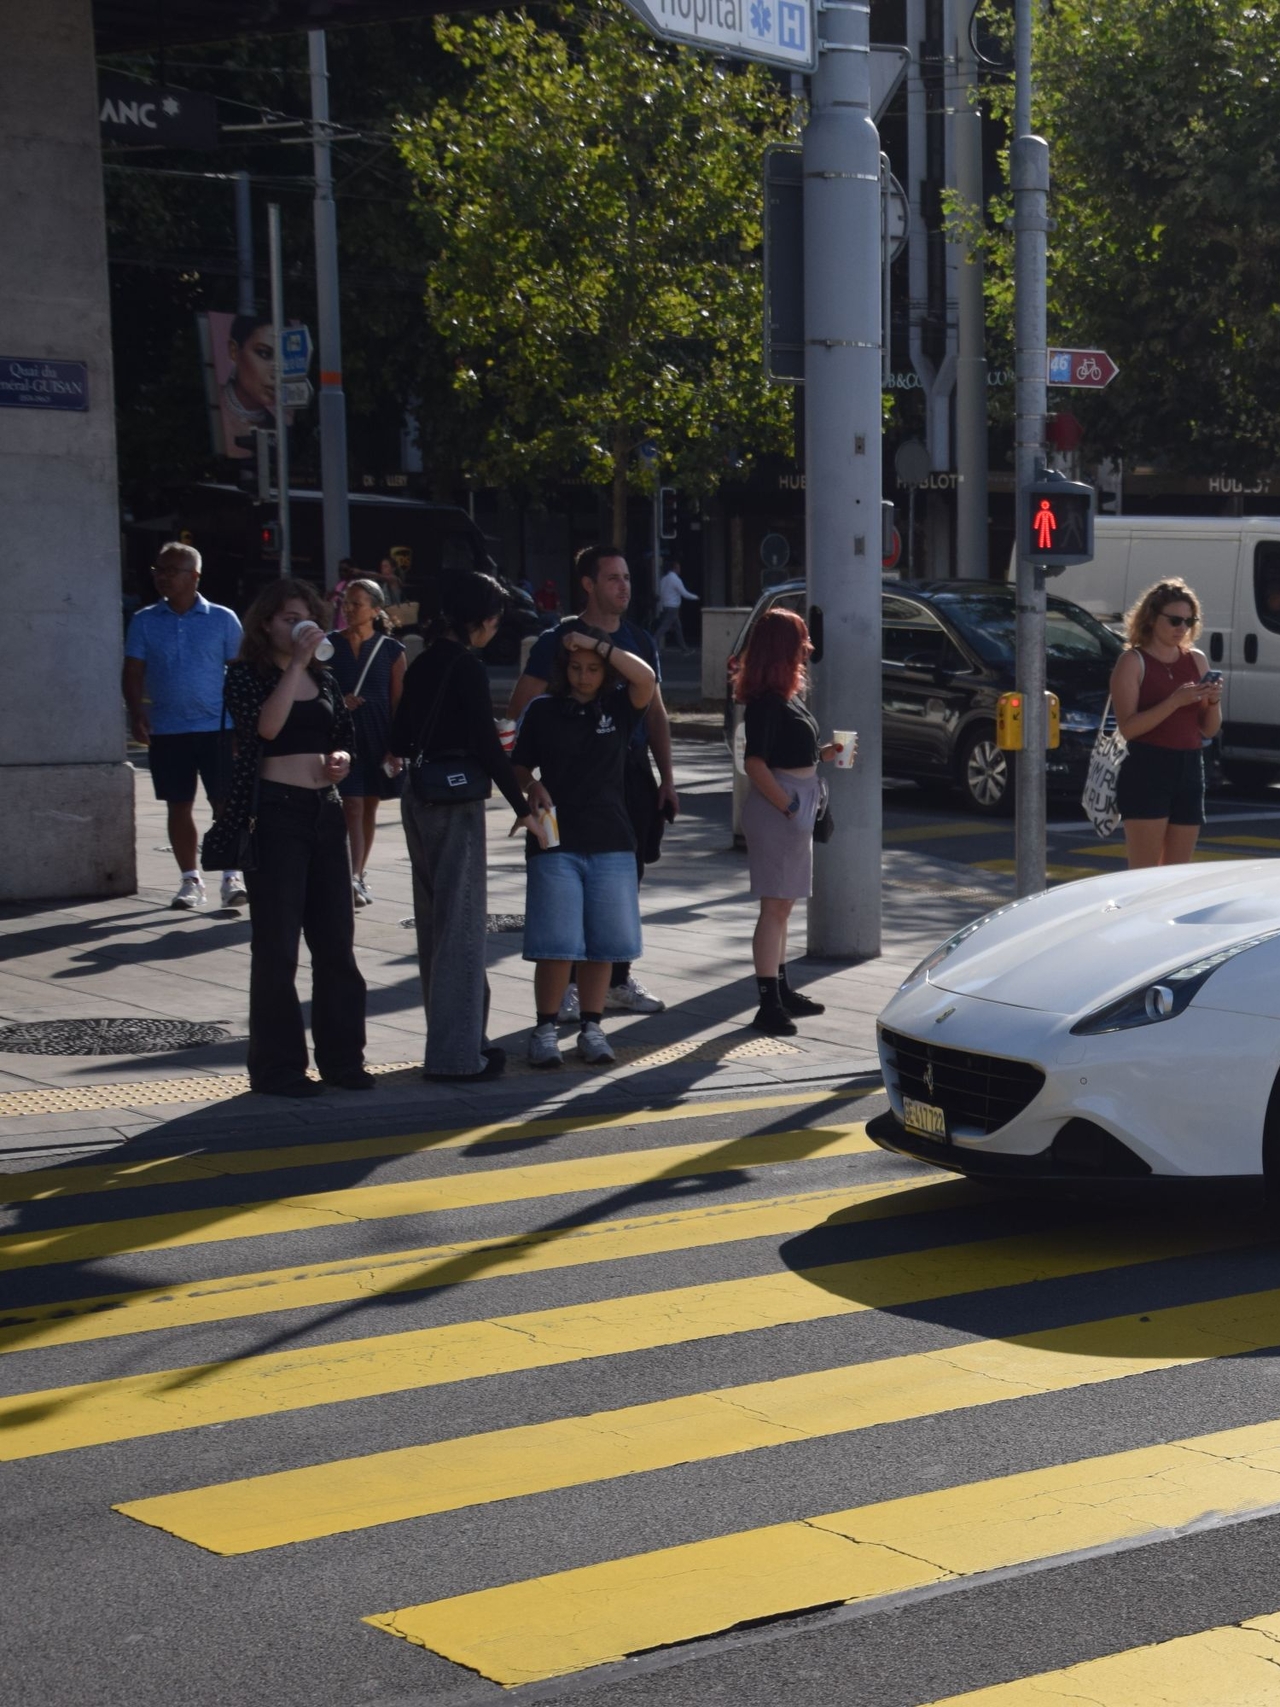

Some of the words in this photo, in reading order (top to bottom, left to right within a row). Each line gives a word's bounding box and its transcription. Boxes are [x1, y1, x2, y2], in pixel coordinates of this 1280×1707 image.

[9, 362, 40, 379] Quai
[41, 364, 58, 379] du
[1050, 354, 1069, 372] 46
[896, 474, 958, 490] HBLOT
[1209, 477, 1271, 494] HUBOT
